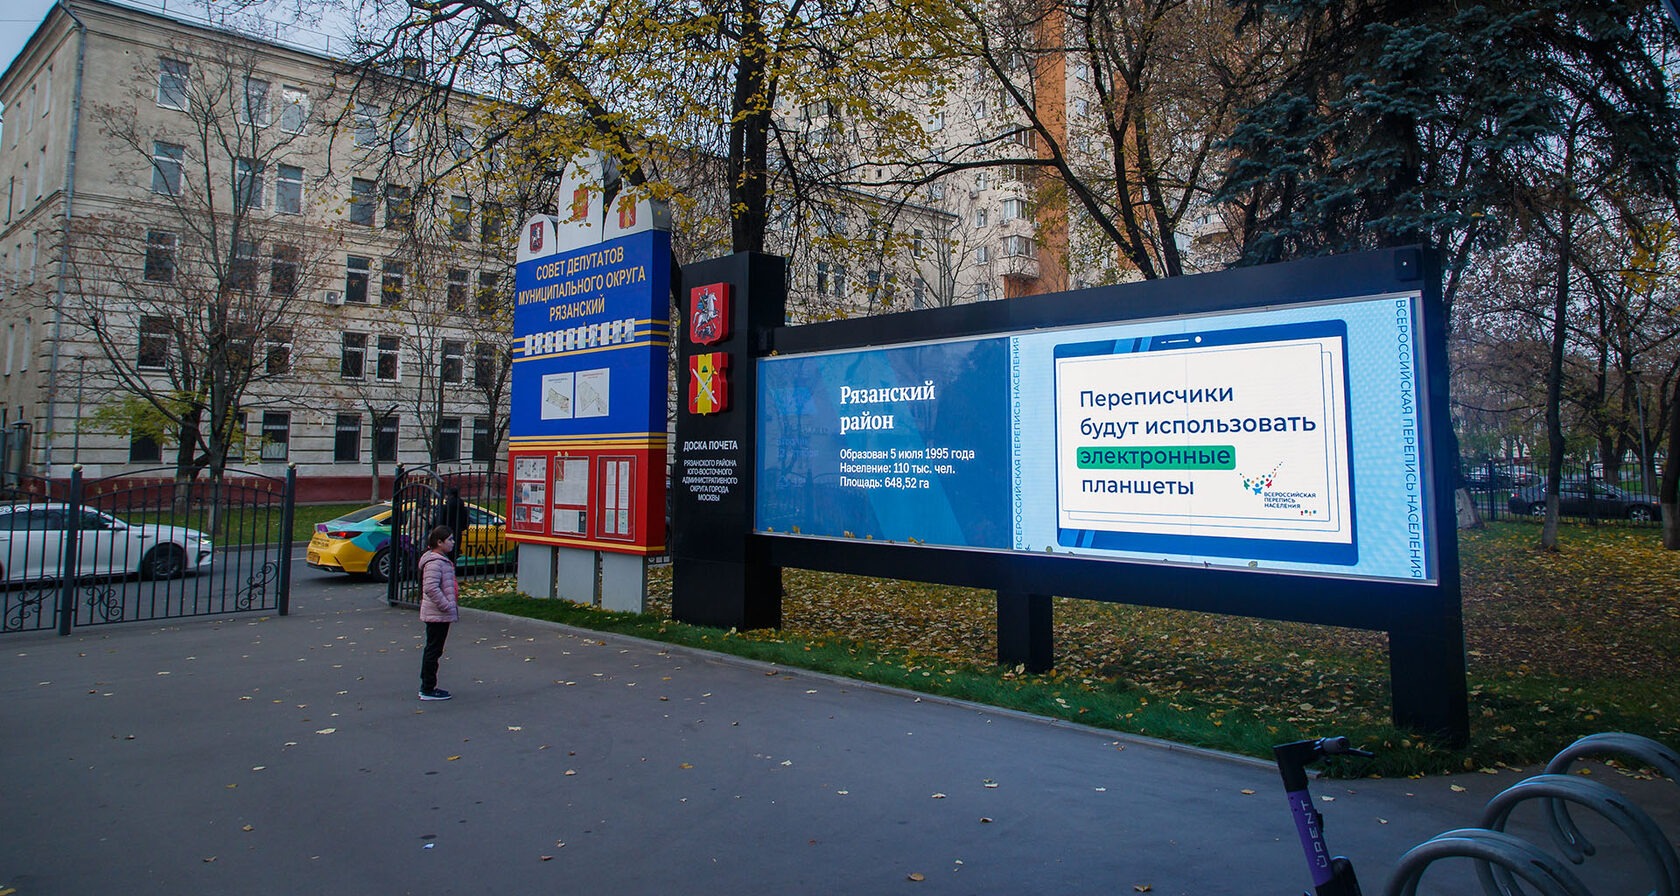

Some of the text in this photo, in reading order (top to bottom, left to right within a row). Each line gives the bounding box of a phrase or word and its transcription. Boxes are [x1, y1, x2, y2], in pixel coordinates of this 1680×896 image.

[536, 246, 624, 281] СОВЕТ ДЕПУТАТОВ
[518, 266, 646, 305] МУНИЦИПАЛЬНОГО ОКРУГА
[550, 294, 605, 322] РЯЗАНСКИЙ
[840, 380, 936, 404] Рязанский
[1080, 387, 1234, 410] Переписчики
[840, 411, 894, 434] район
[1080, 416, 1316, 439] будут использовать
[684, 441, 738, 452] ДОСКА ПОЧЕТА
[1396, 300, 1422, 578] ВСЕРОССИЙСКАЯ ПЕРЕПИСЬ НАСЕЛЕНИЯ
[716, 458, 737, 466] РАЙОНА
[840, 448, 975, 461] Образован 5 июля 1995 года
[1080, 448, 1231, 468] электронные
[840, 463, 956, 474] Население: 110 тыс. чел.
[682, 476, 738, 484] АДМИНИСТРАТИВНОГО
[840, 477, 930, 490] Площадь: 648,52 га
[1082, 479, 1194, 495] планшеты
[1014, 460, 1022, 550] ВСЕРОССИЙСКАЯ
[467, 544, 503, 557] TAXI
